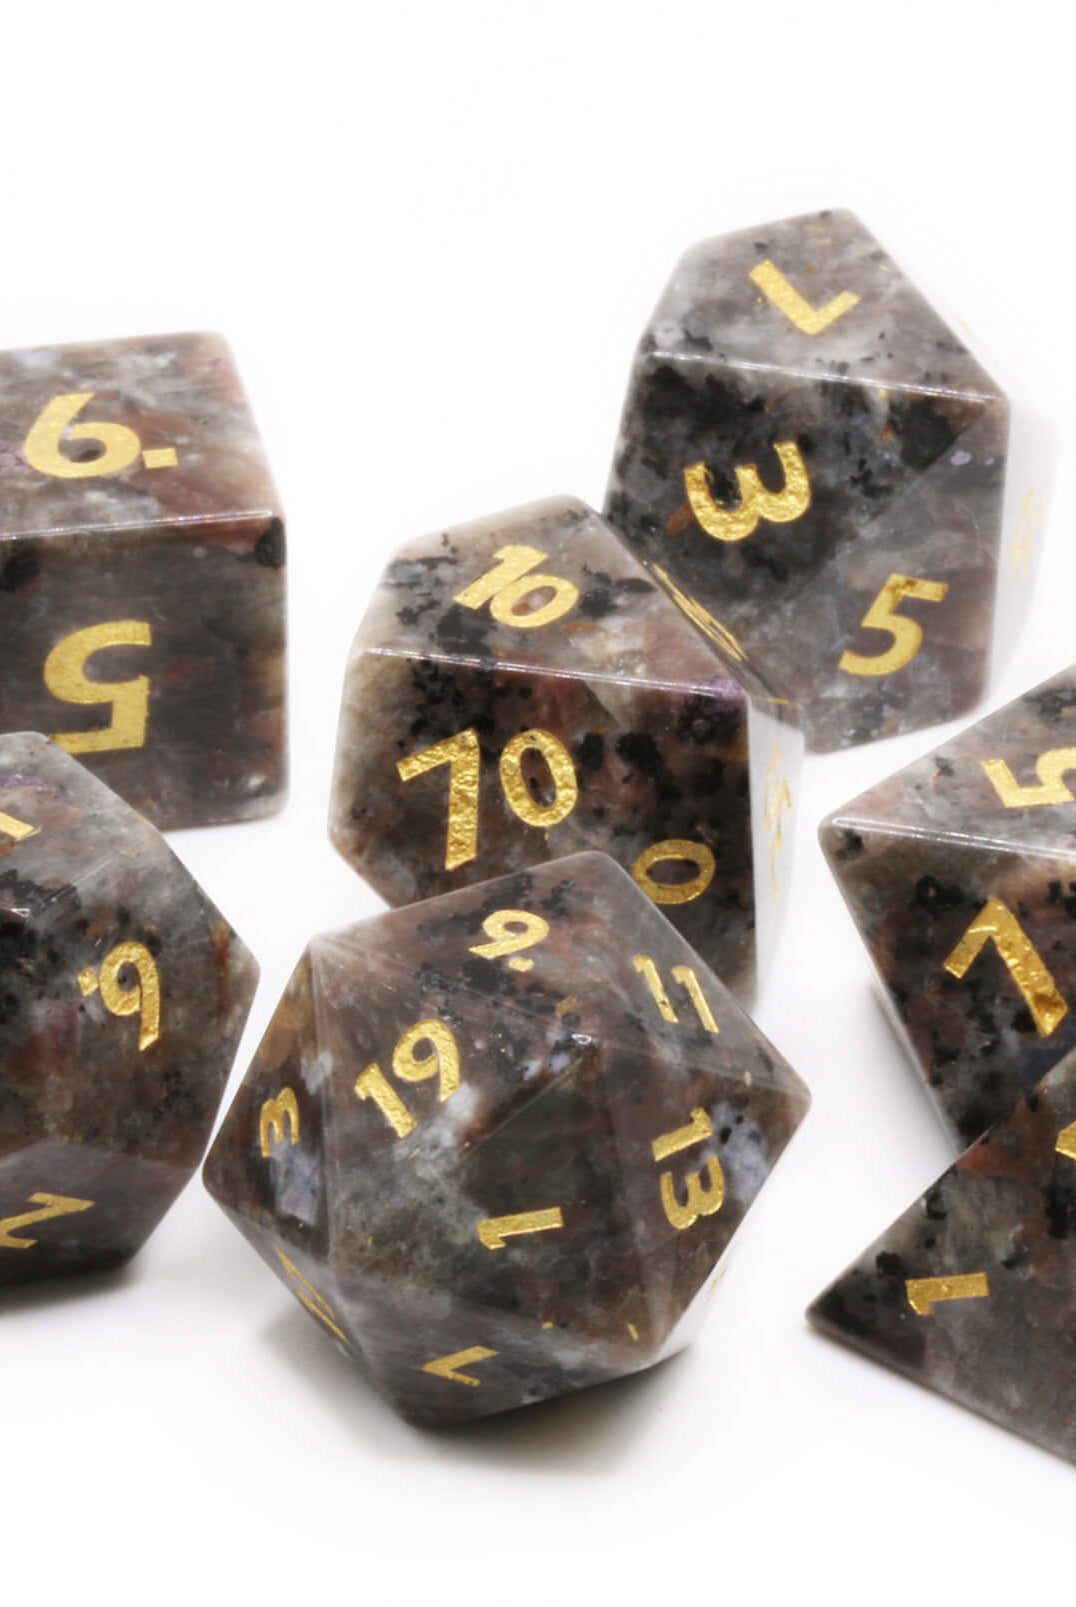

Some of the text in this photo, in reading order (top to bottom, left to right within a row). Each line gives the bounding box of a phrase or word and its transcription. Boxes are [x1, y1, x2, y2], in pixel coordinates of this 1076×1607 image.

[749, 258, 862, 336] 7
[684, 440, 811, 544] 3
[453, 543, 580, 629] 10
[839, 573, 949, 677] 5
[44, 620, 153, 754] 5
[395, 727, 580, 872] 70
[632, 954, 720, 1034] 11
[943, 895, 1069, 1039] 7
[258, 1085, 300, 1159] 3
[354, 1018, 461, 1138] 19
[651, 1106, 726, 1231] 13
[477, 1205, 564, 1250] 1
[905, 1271, 990, 1317] 1
